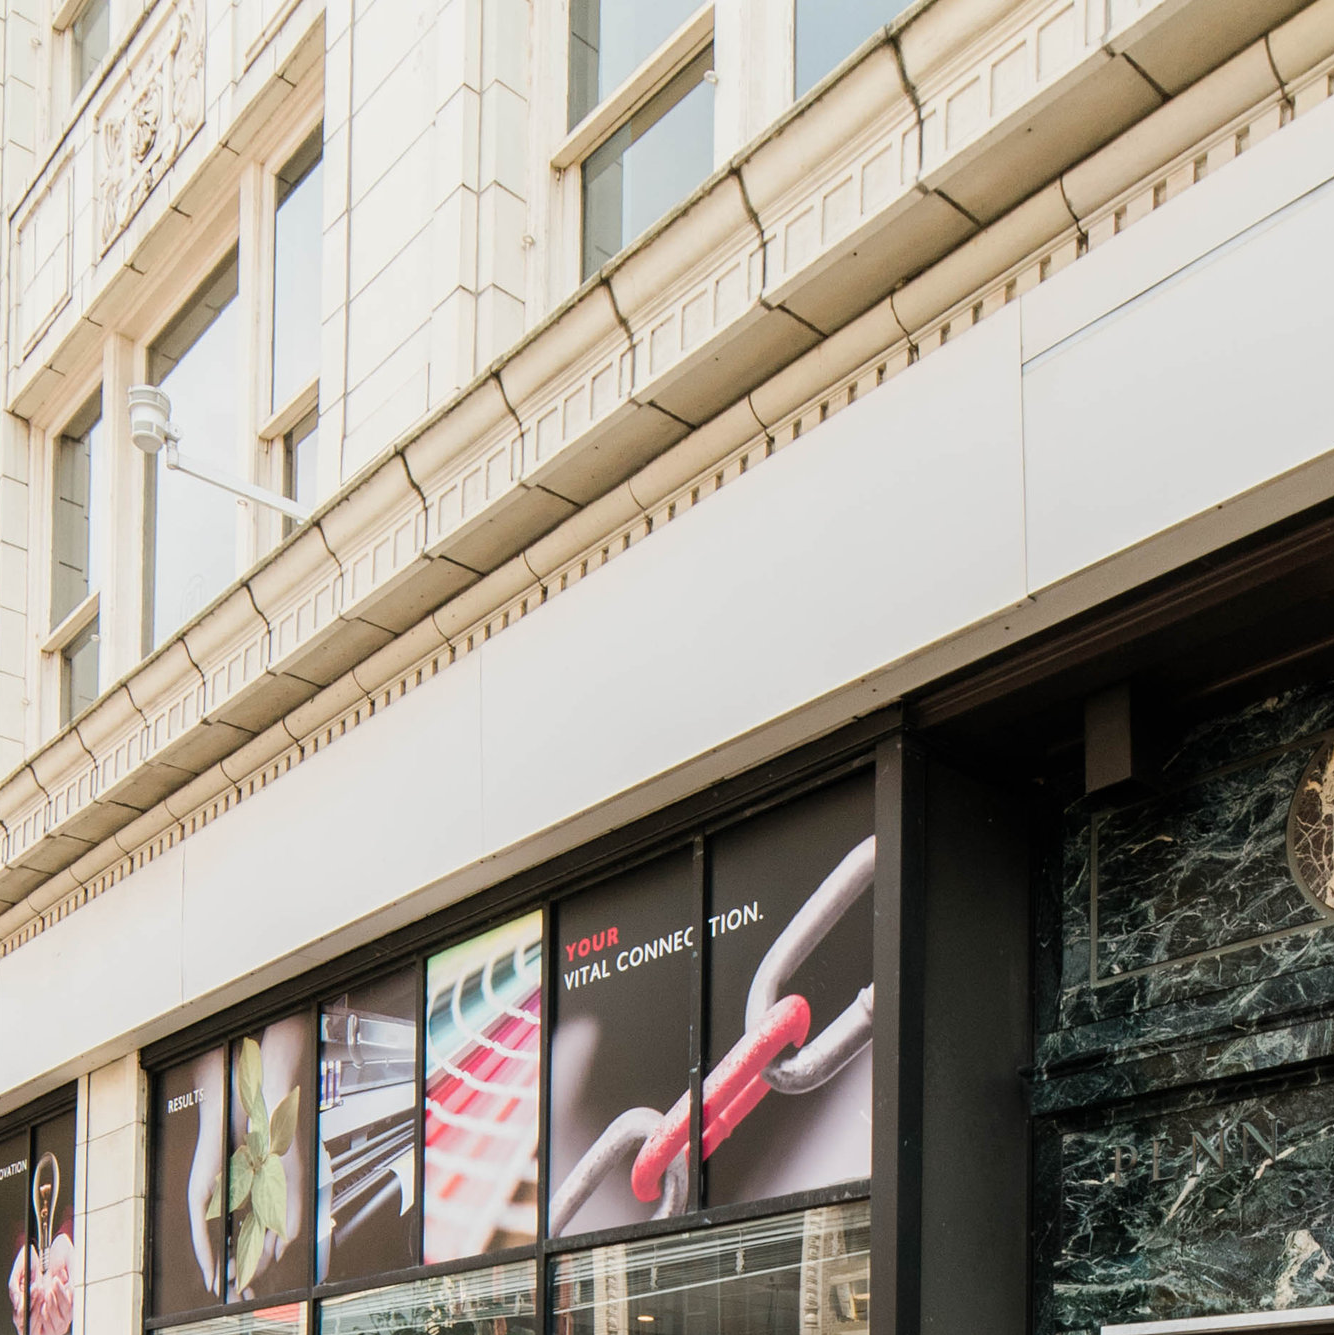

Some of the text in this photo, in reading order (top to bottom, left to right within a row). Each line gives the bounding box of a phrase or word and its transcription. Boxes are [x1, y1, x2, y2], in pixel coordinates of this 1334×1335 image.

[565, 926, 620, 963] YOUR
[564, 956, 612, 991] VITAL
[1114, 1117, 1280, 1187] PENN
